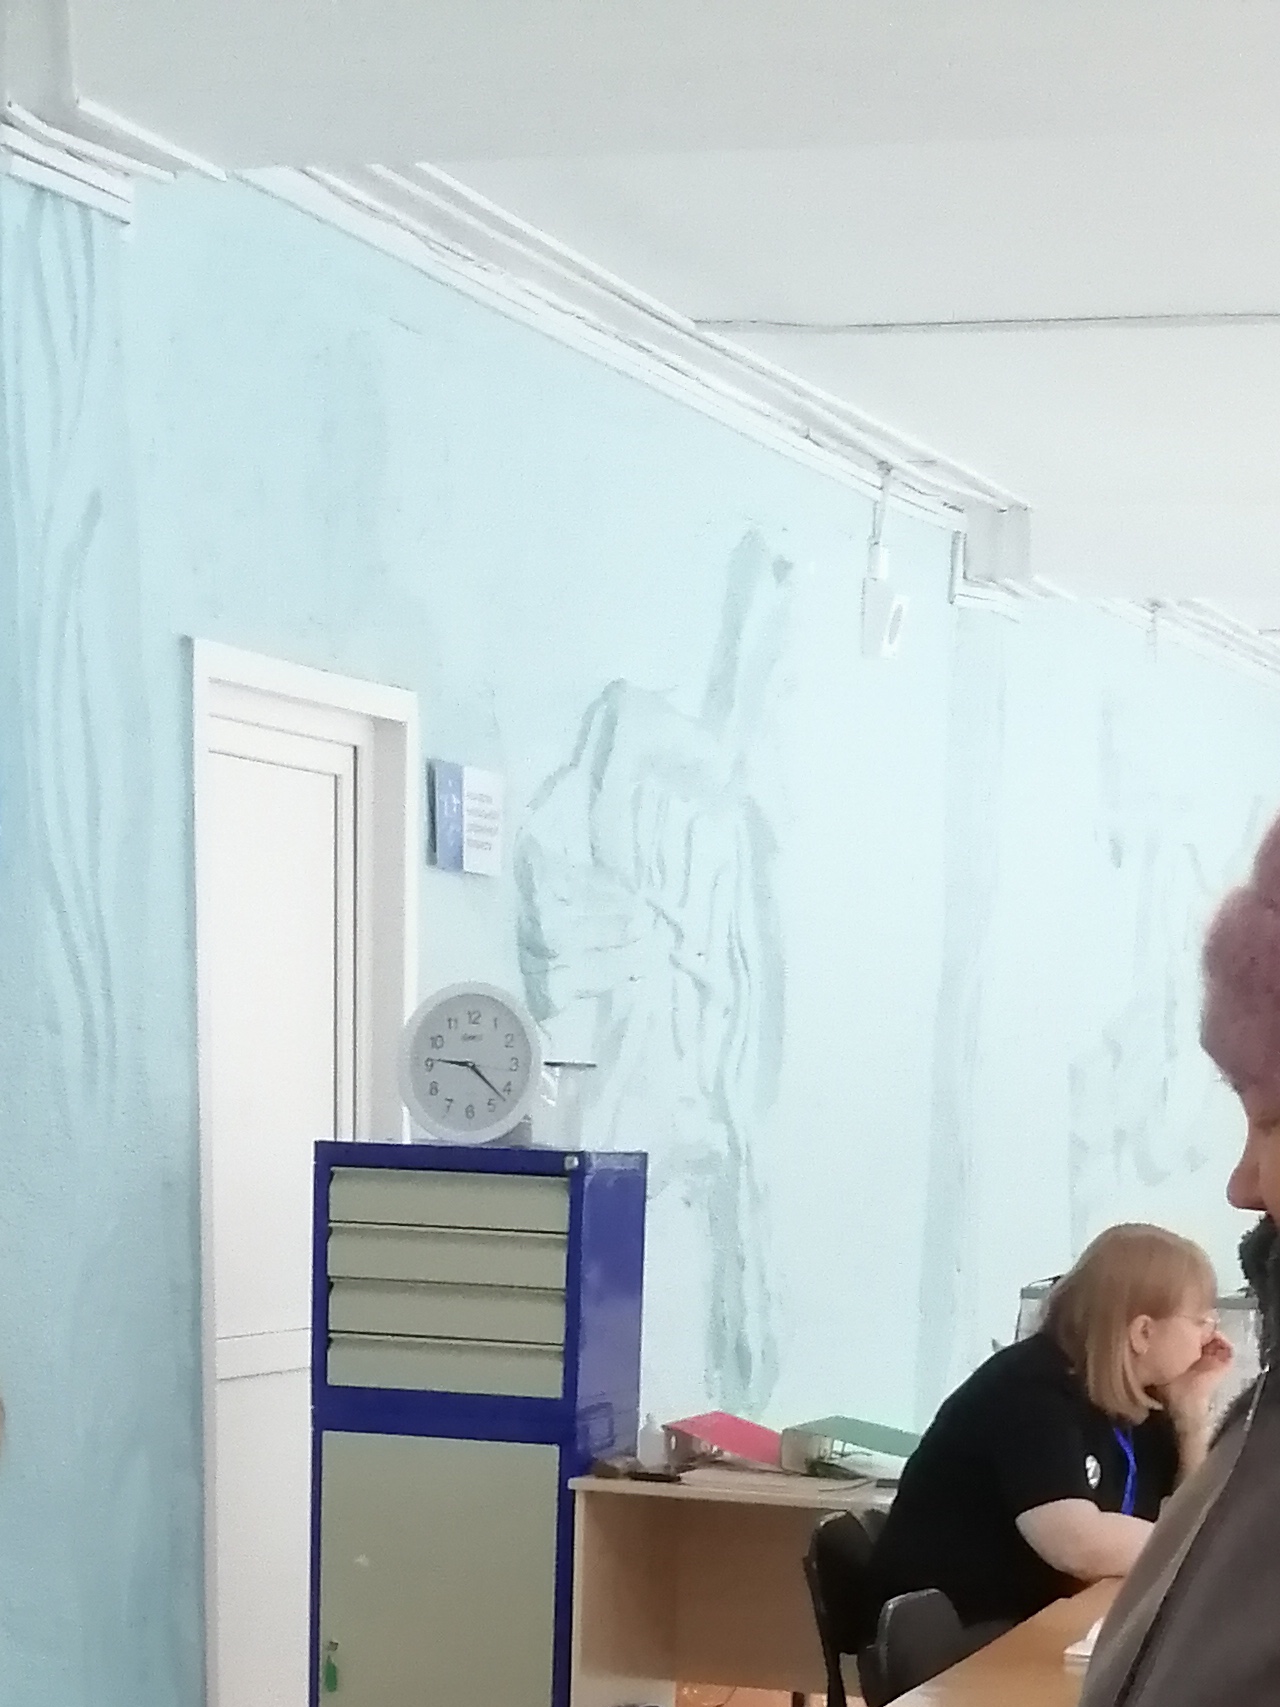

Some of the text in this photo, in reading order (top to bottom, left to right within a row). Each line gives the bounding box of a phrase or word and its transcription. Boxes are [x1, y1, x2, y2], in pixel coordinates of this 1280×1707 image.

[447, 1017, 458, 1030] 11
[467, 1010, 481, 1025] 12
[430, 1034, 445, 1050] 10
[504, 1033, 514, 1048] 2
[424, 1057, 434, 1072] 9
[509, 1056, 519, 1072] 3
[429, 1080, 439, 1096] 8
[502, 1080, 512, 1095] 4
[444, 1097, 454, 1113] 7
[464, 1104, 475, 1119] 6
[487, 1098, 496, 1113] 5
